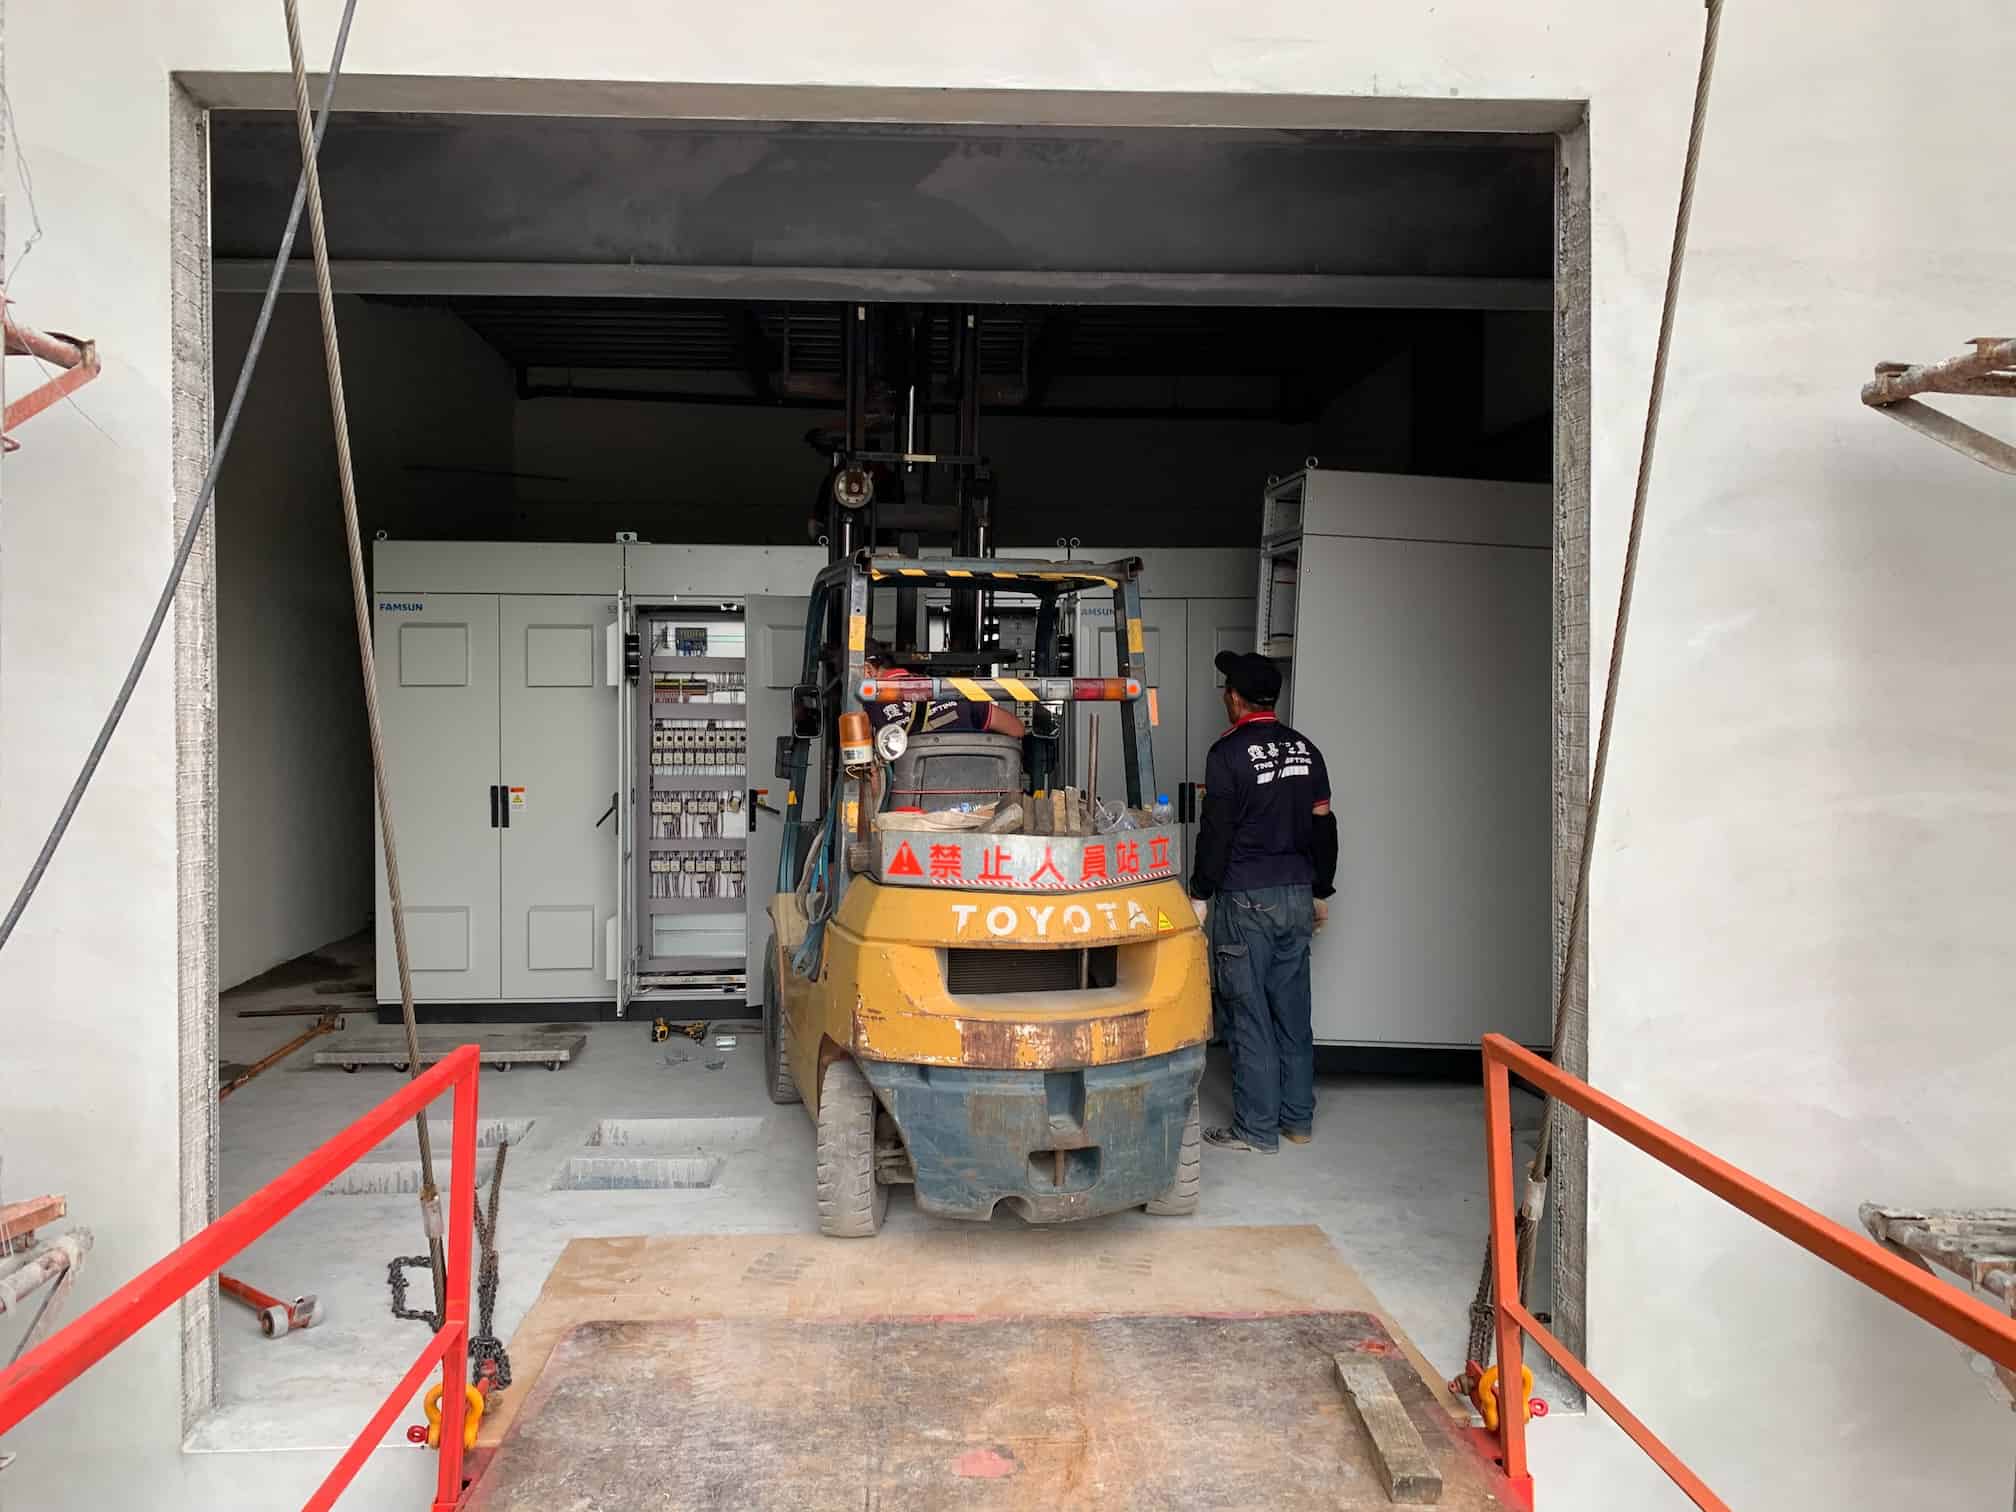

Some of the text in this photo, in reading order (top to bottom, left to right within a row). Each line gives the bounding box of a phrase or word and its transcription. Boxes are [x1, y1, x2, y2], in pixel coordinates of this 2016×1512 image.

[379, 603, 423, 612] FAMSUN
[928, 834, 1171, 882] 禁止人員站立
[951, 899, 1152, 937] TOYOTA
